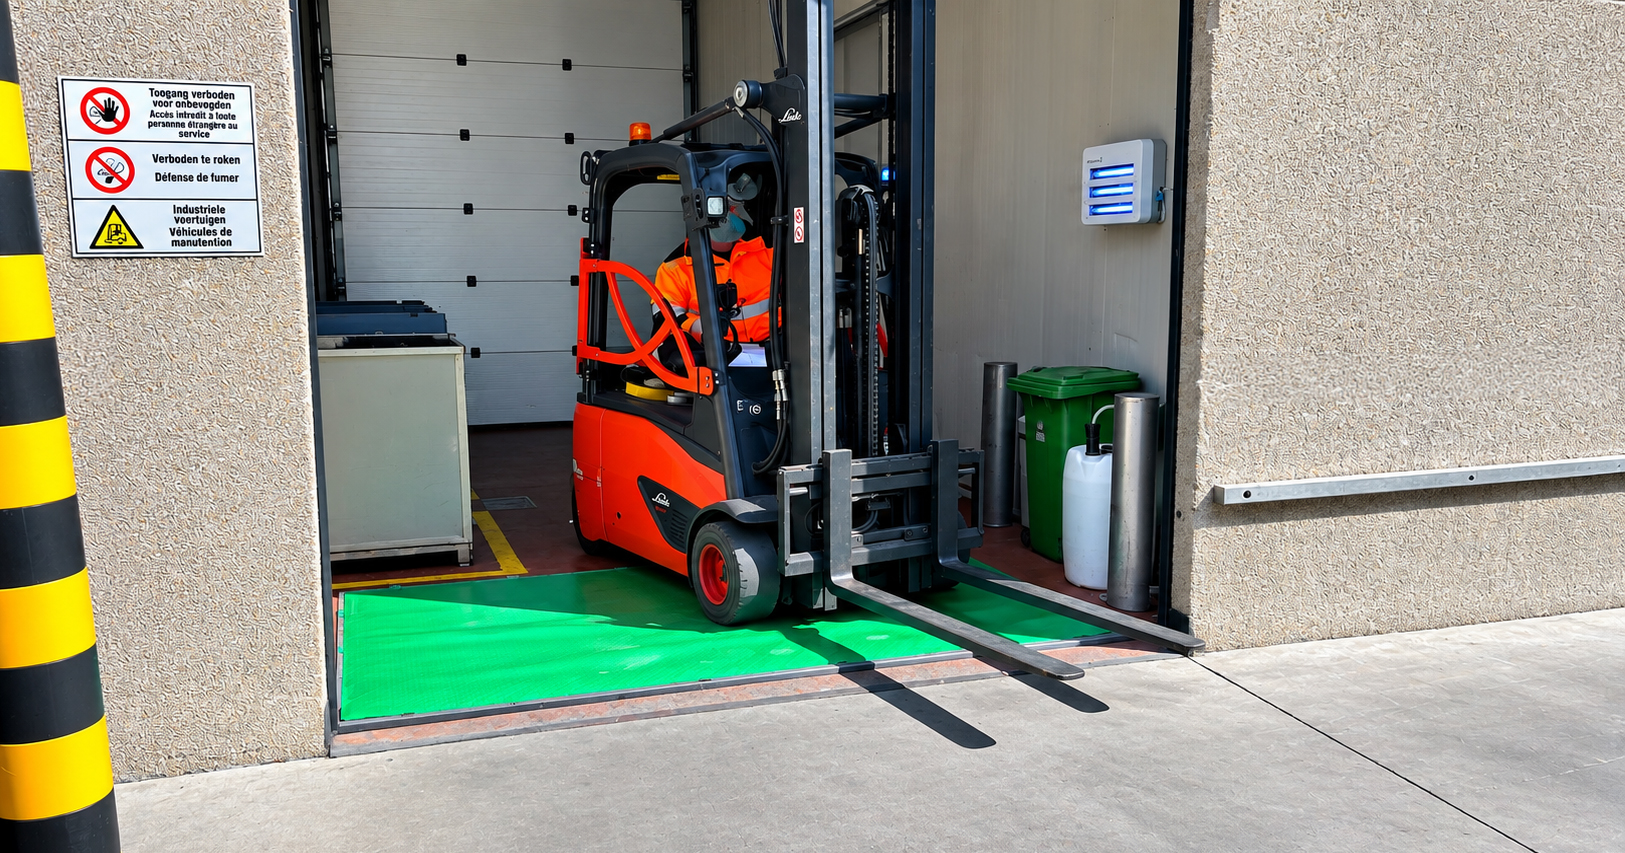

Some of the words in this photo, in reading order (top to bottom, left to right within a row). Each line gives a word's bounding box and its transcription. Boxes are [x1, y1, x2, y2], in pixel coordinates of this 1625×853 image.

[191, 90, 236, 100] verboden
[152, 100, 174, 108] voor
[178, 130, 211, 139] service
[151, 153, 199, 164] Verboden
[200, 154, 211, 165] te
[213, 154, 241, 165] roken
[154, 171, 195, 183] Défense
[196, 172, 209, 183] de
[210, 172, 240, 183] fumer
[172, 204, 226, 215] Industriele
[173, 214, 227, 227] voertuigen
[168, 226, 218, 237] Véhicules
[219, 226, 233, 237] de
[171, 237, 232, 247] manutention
